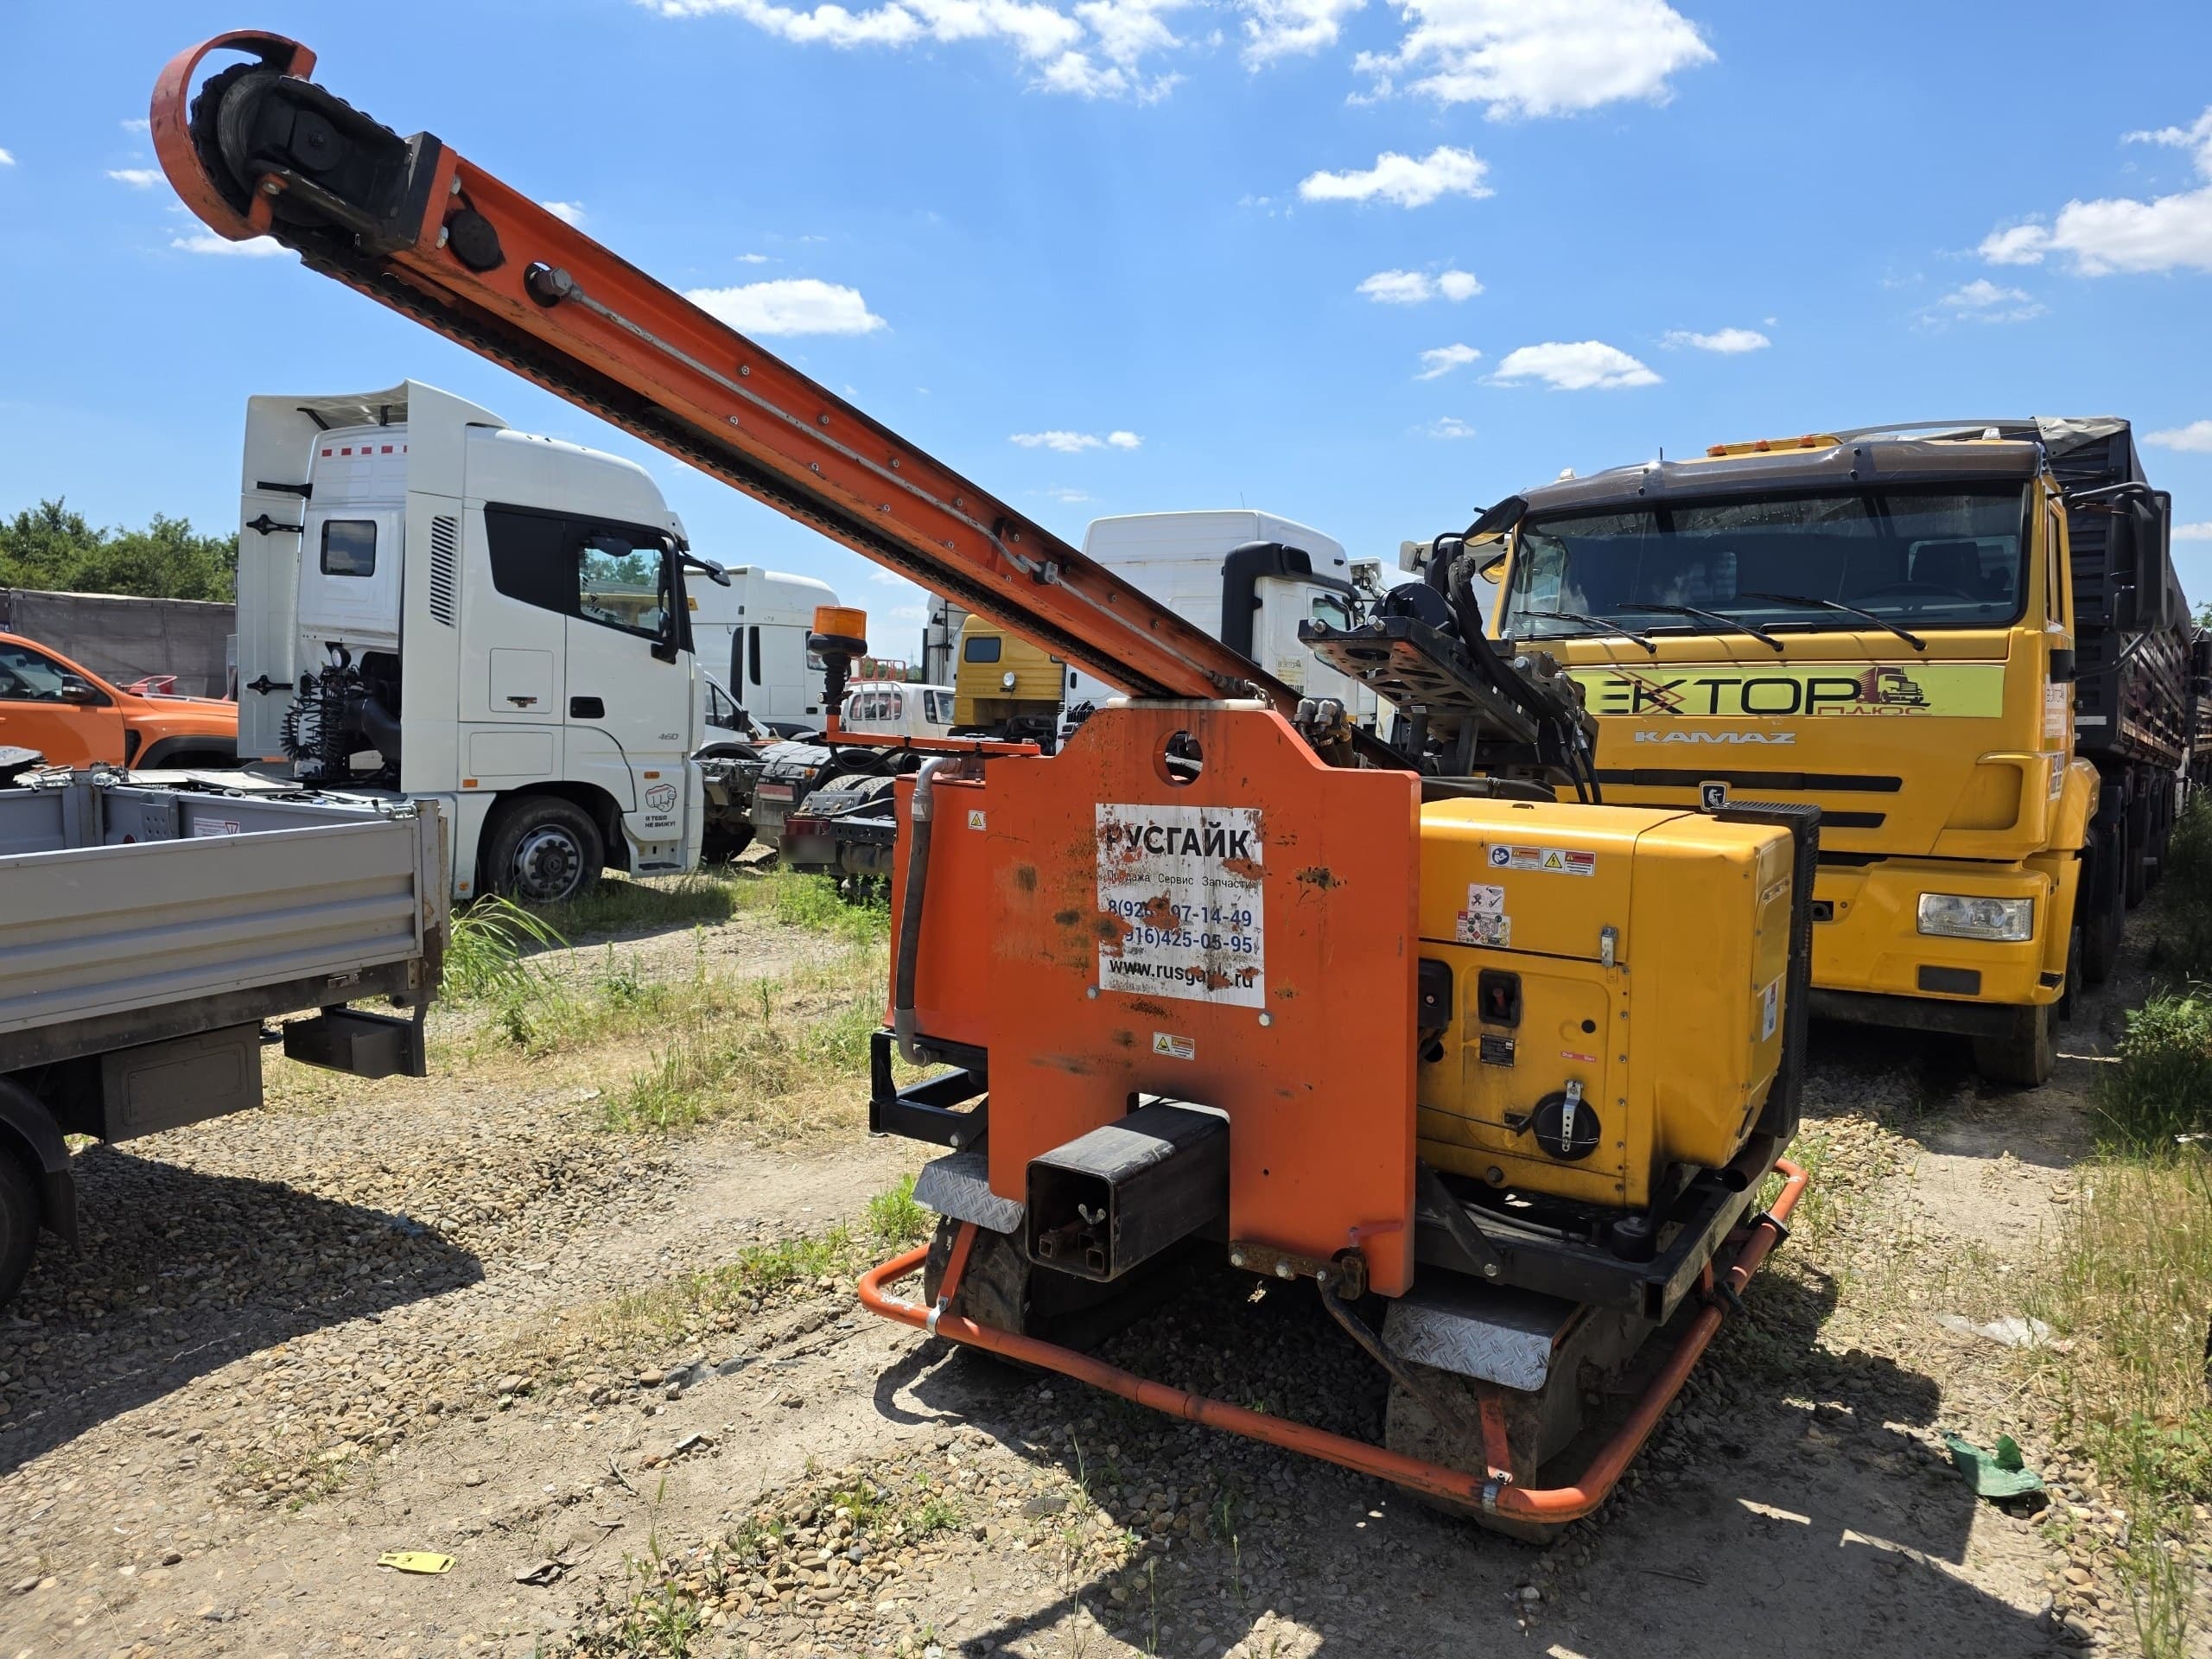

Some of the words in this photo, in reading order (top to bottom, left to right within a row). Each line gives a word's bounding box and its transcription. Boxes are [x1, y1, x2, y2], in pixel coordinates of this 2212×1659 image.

[1600, 677, 1863, 715] ЕКТОР
[1634, 730, 1798, 744] KAMAZ
[1106, 821, 1251, 858] РУСГАЙК
[1158, 873, 1194, 888] Сервис
